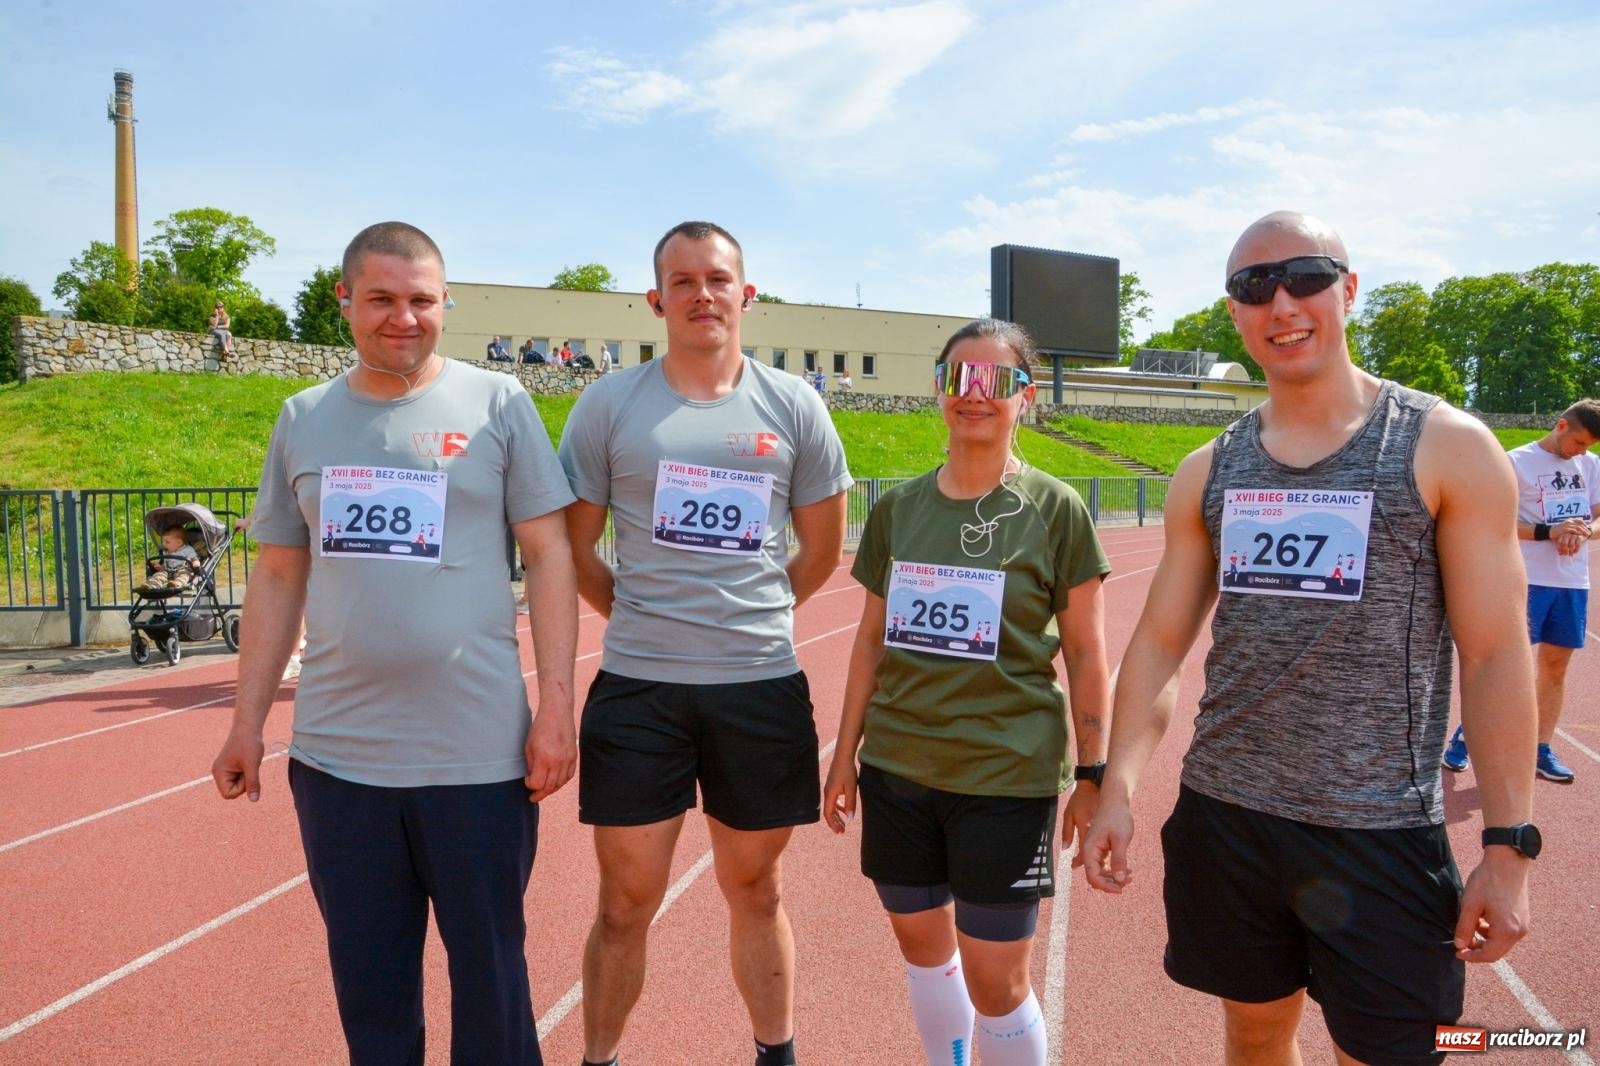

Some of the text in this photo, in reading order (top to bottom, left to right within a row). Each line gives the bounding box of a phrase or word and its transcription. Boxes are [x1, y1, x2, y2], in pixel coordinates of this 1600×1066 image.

[331, 469, 348, 477] XVII
[351, 469, 373, 477] BIEG
[398, 471, 438, 483] GRANIC
[668, 464, 685, 473] XVII
[688, 467, 708, 476] BIEG
[710, 470, 727, 479] BEZ
[730, 472, 765, 484] GRANIC
[671, 478, 689, 486] maja
[1235, 493, 1360, 504] XVII BIEG BEZ GRANIC
[680, 500, 742, 531] 269
[1239, 508, 1260, 518] maja
[1557, 503, 1580, 516] 247
[345, 503, 412, 535] 268
[1252, 532, 1329, 568] 267
[916, 567, 935, 575] BIEG
[938, 568, 955, 577] BEZ
[957, 570, 995, 581] GRANIC
[902, 578, 917, 586] maja
[910, 599, 969, 632] 265
